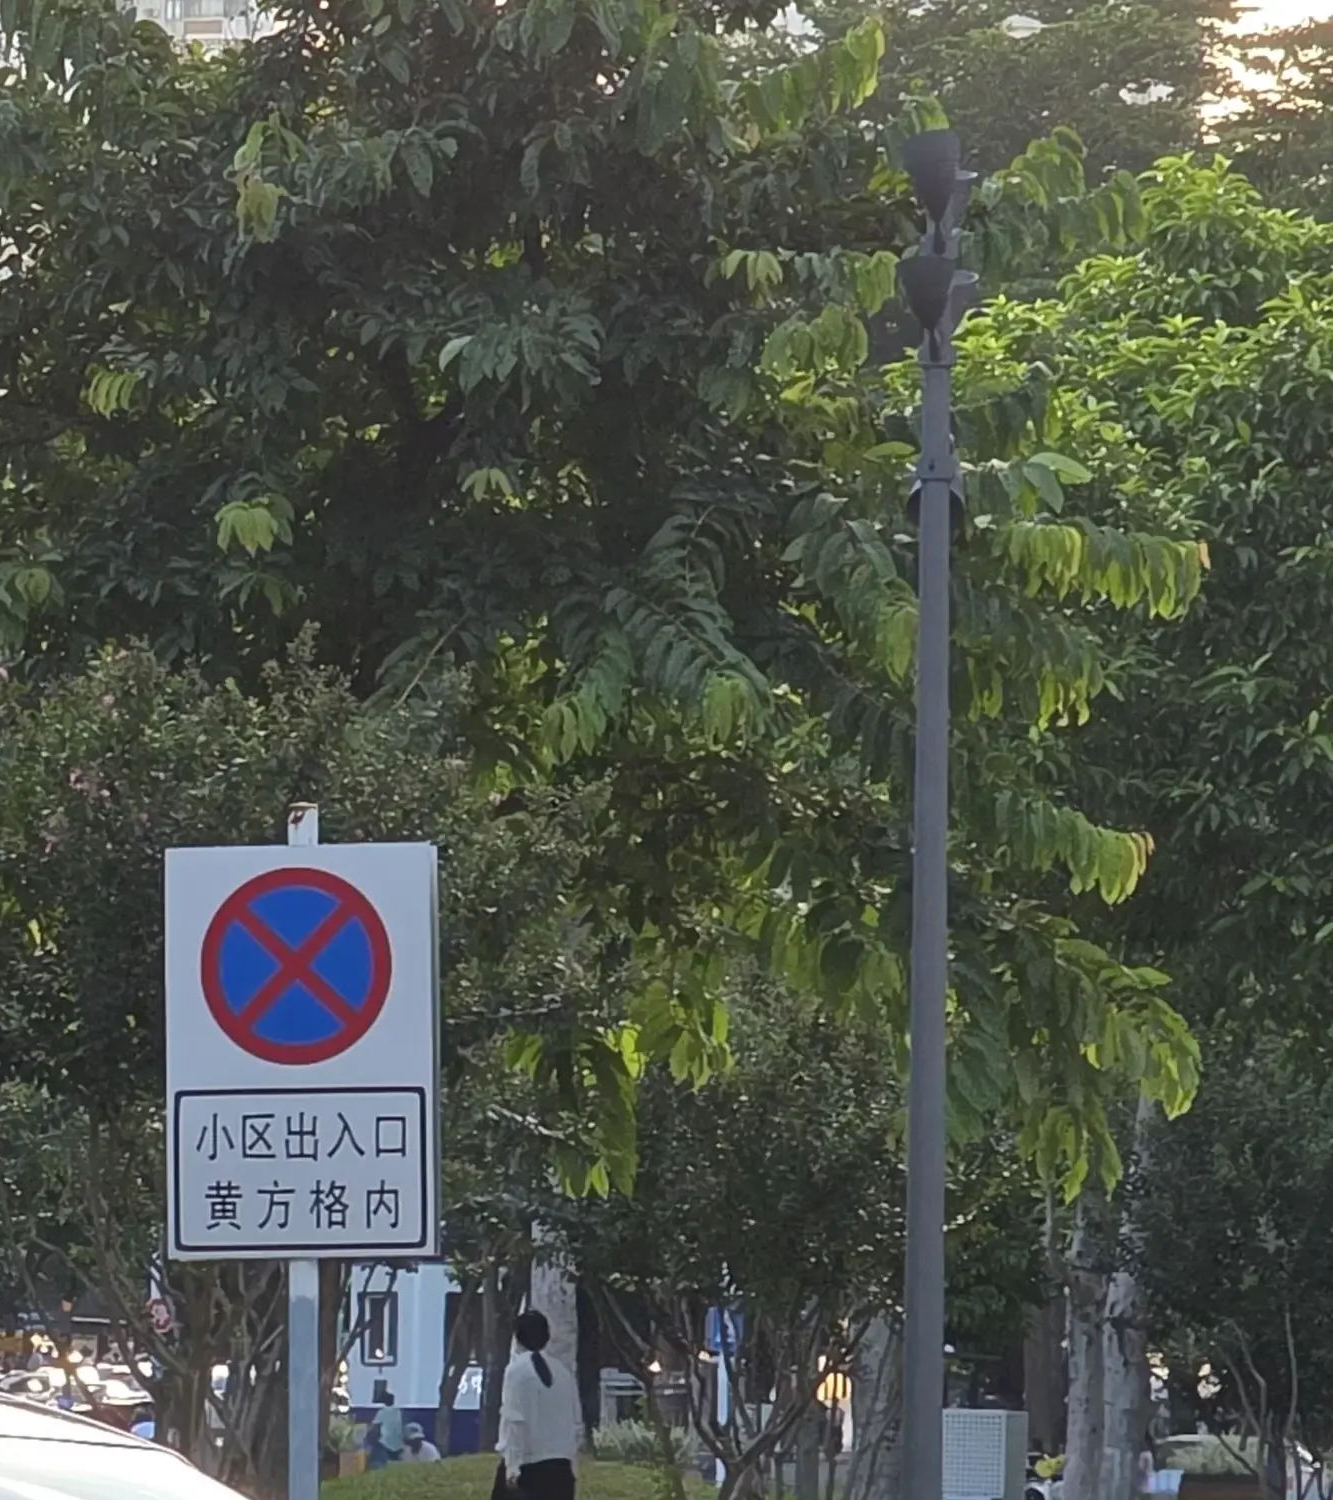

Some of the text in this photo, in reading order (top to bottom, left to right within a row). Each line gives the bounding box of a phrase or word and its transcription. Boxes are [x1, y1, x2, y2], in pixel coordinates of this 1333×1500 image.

[196, 1111, 407, 1162] 小区出入口
[204, 1179, 400, 1230] 黄方格内
